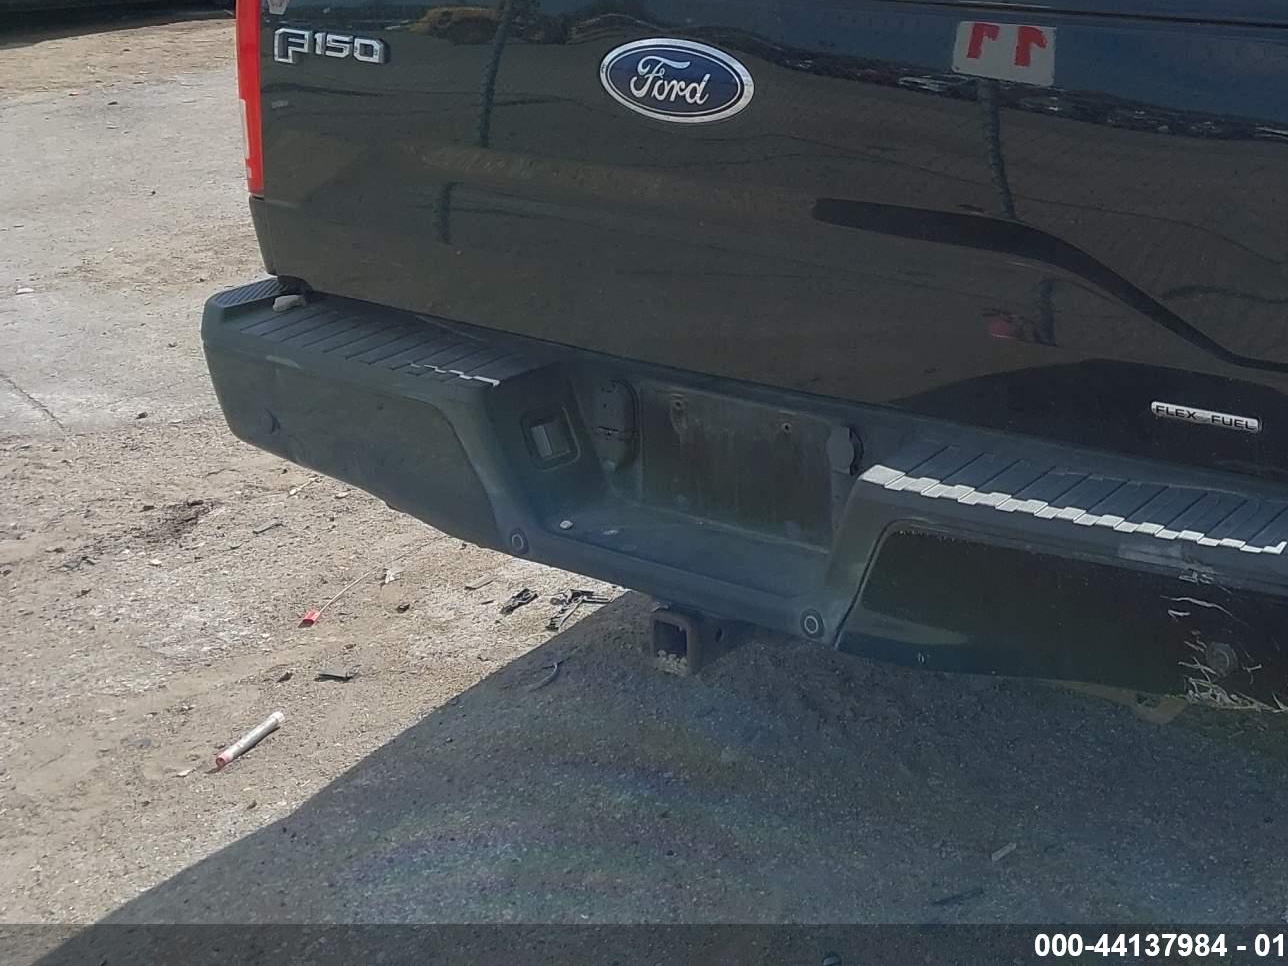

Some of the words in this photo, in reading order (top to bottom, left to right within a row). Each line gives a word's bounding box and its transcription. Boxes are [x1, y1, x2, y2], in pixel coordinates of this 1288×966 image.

[629, 55, 711, 105] Ford
[1155, 404, 1198, 421] FLEX
[1210, 414, 1258, 431] FUEL
